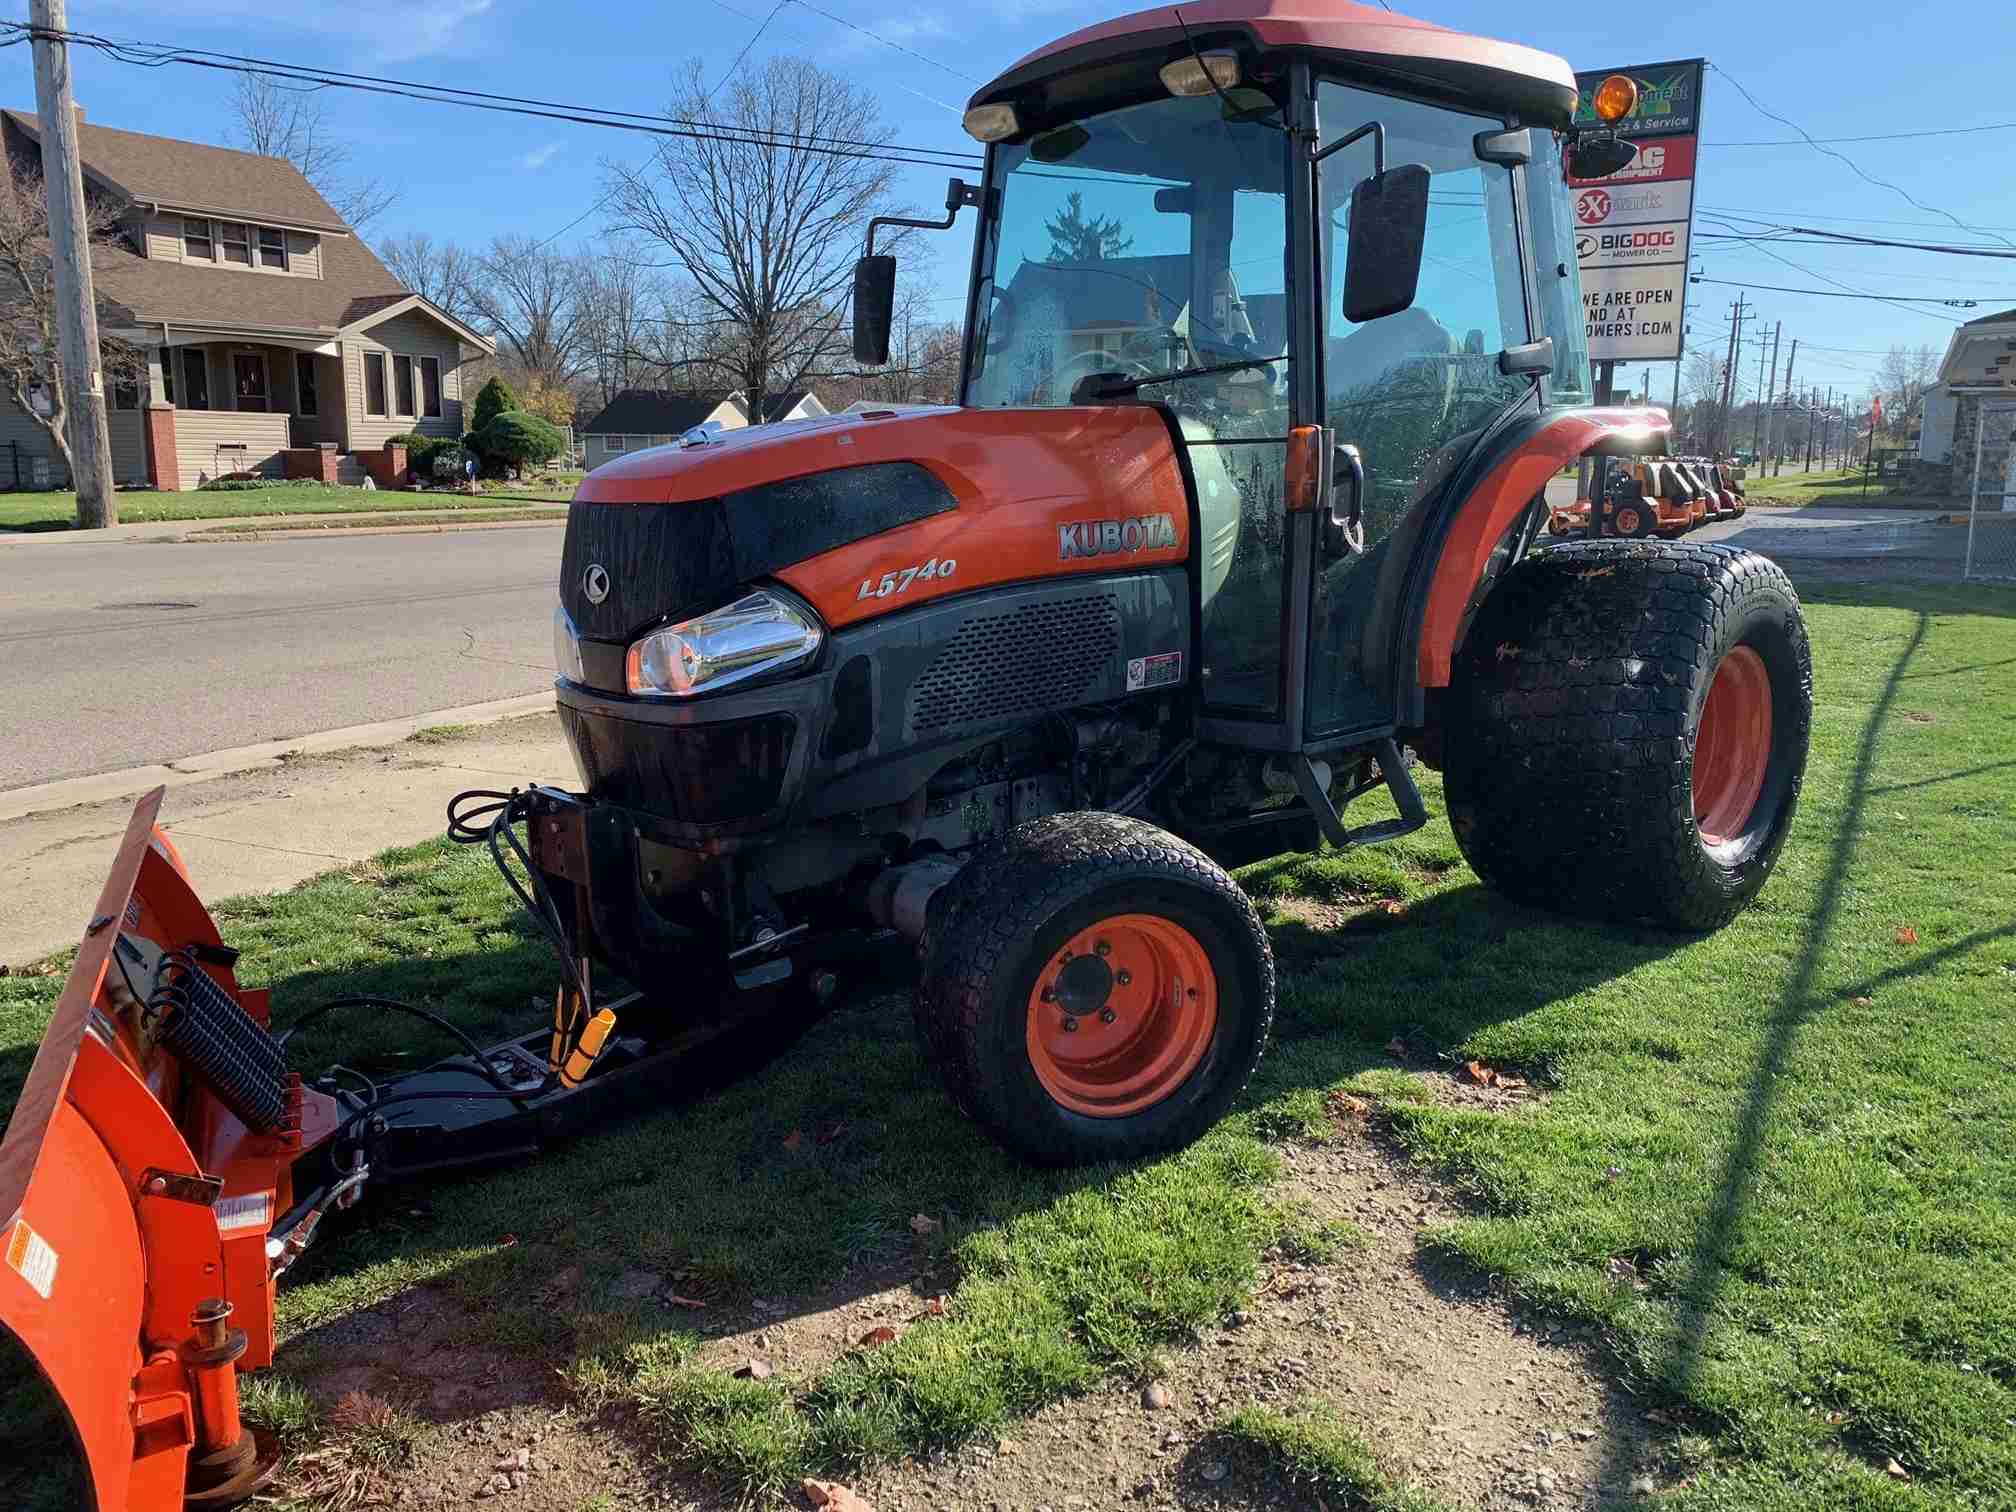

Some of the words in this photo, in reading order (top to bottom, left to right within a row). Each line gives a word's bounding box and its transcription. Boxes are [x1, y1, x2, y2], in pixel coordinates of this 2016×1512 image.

[1645, 117, 1689, 129] Service
[1601, 231, 1675, 249] BIGDOG
[1604, 291, 1632, 305] ARE
[1636, 289, 1672, 304] OPEN
[1617, 307, 1636, 320] AT
[1057, 511, 1176, 560] KUBOTA
[857, 559, 956, 600] L5740
